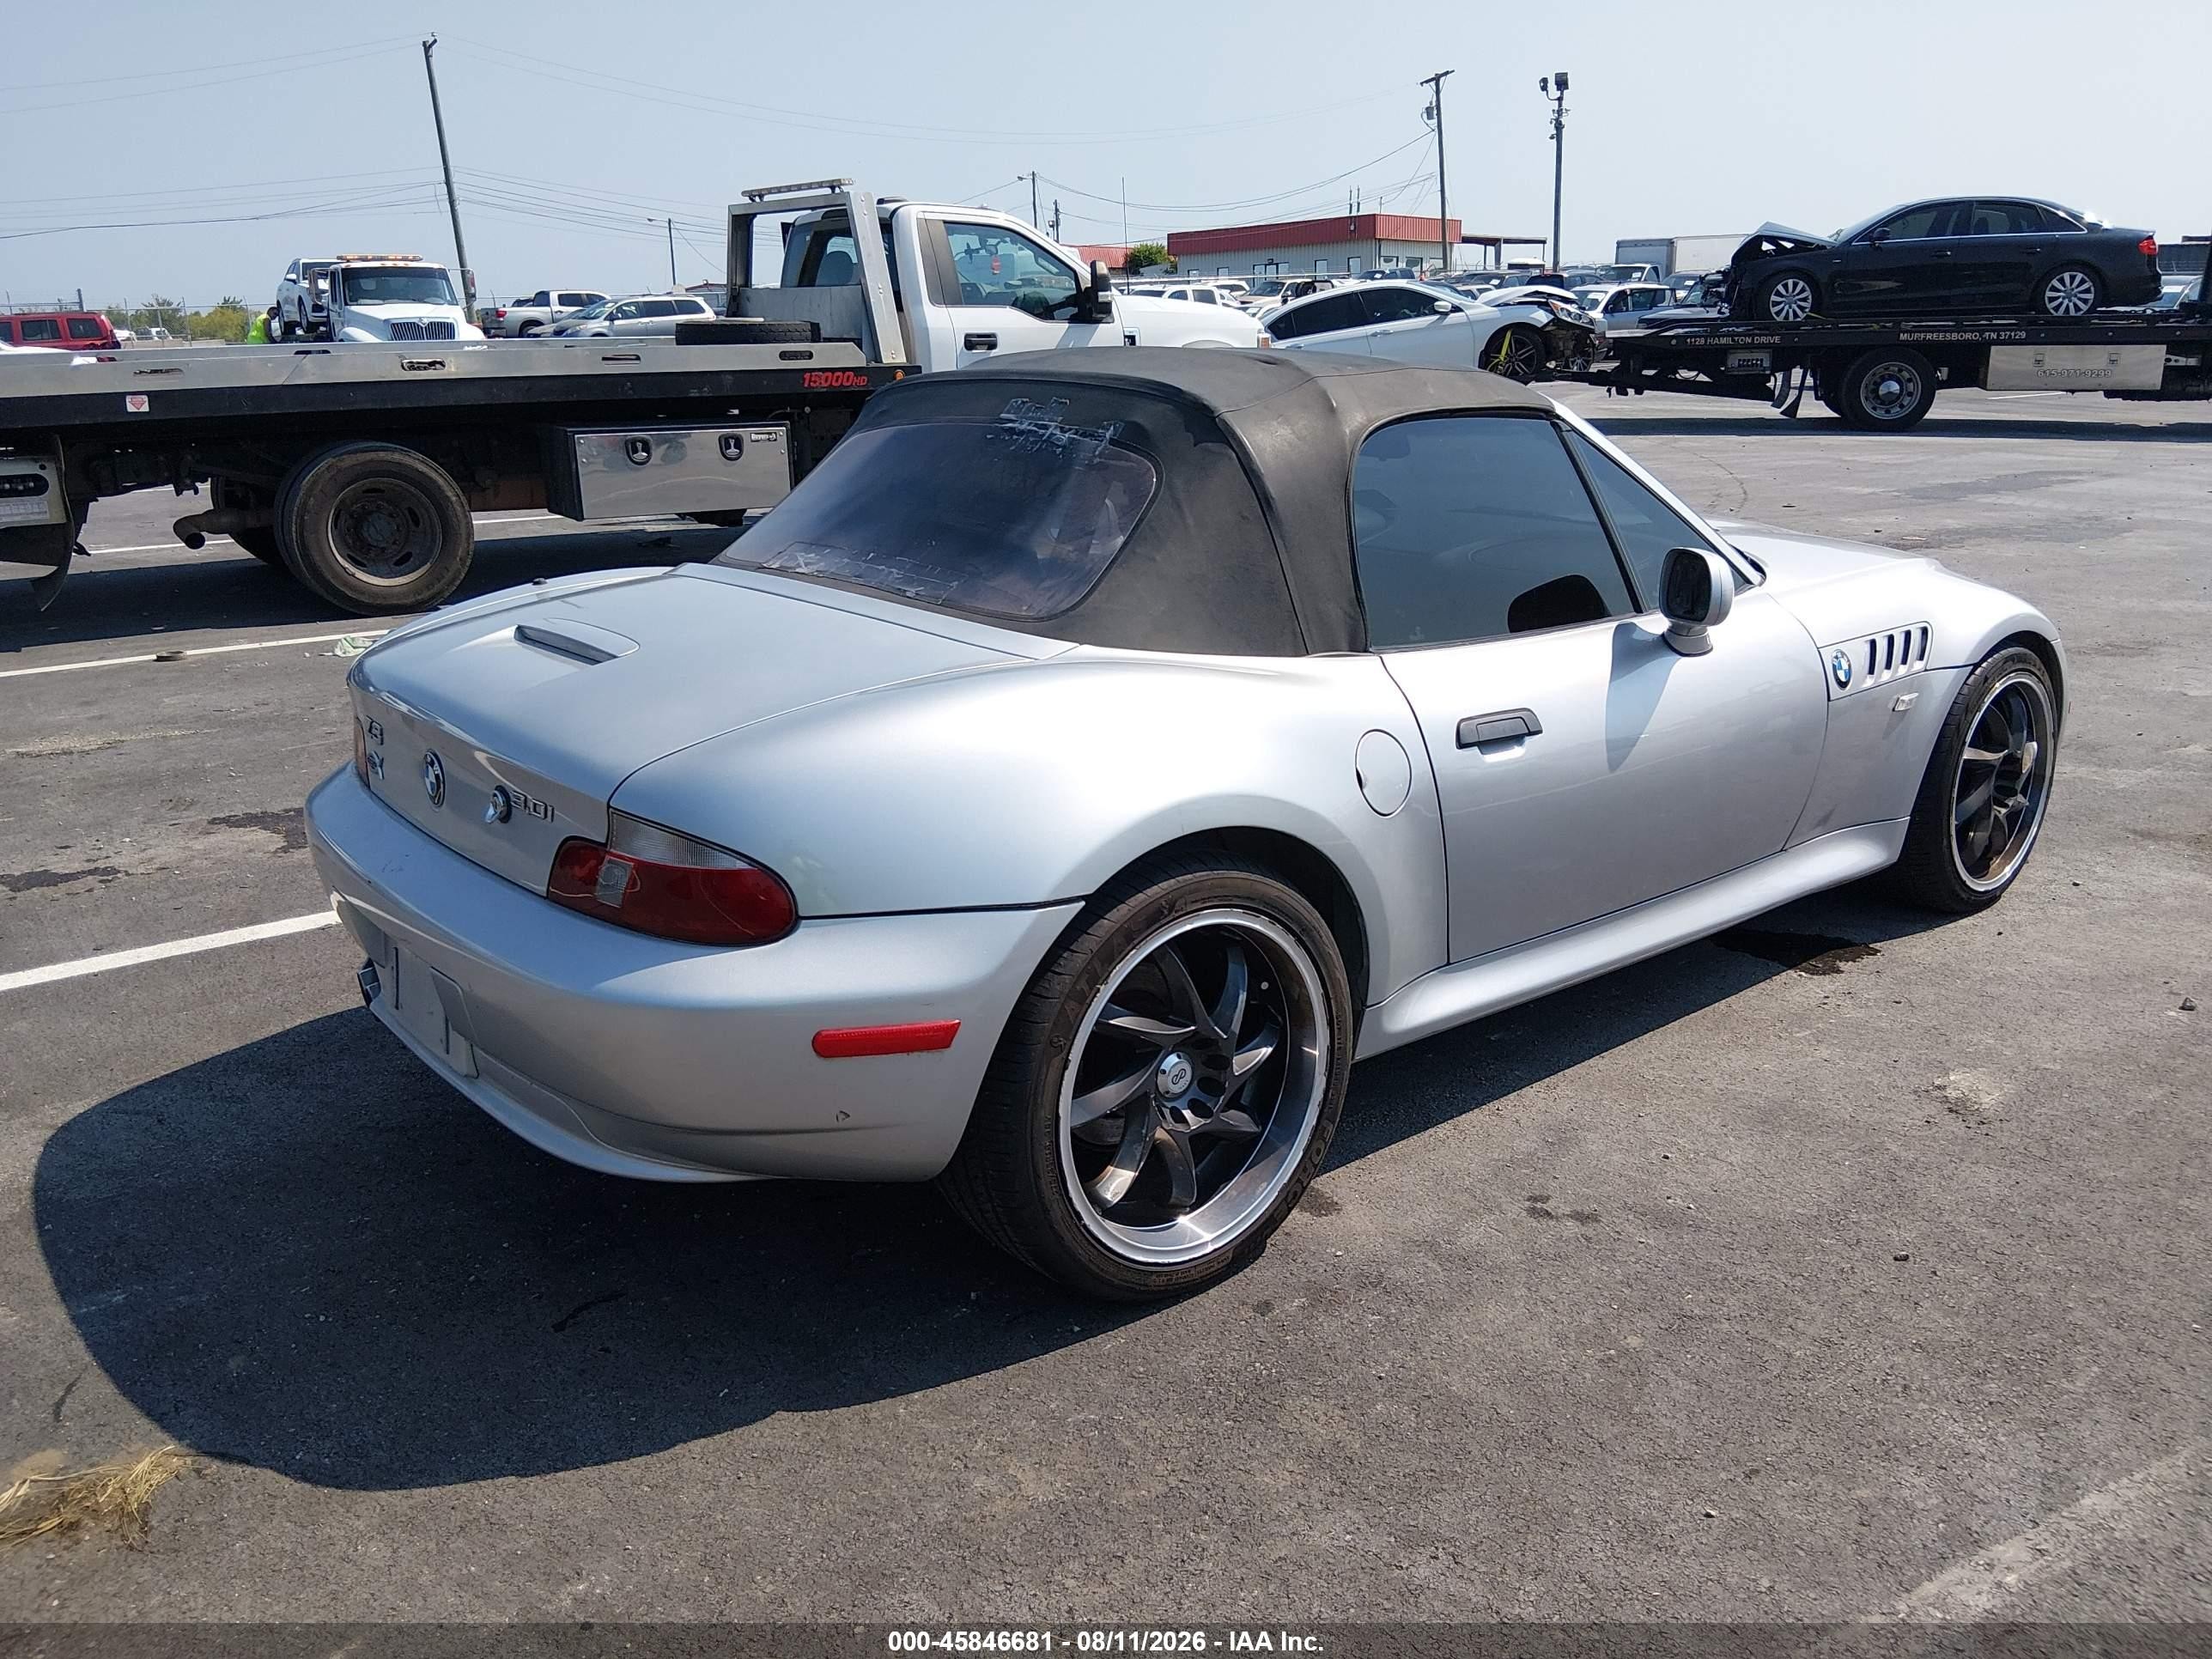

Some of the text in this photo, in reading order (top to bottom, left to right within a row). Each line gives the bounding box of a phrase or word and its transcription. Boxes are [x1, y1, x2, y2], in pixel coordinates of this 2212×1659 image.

[1706, 336, 1752, 344] HAMILTON
[1753, 335, 1782, 343] DRIVE
[1984, 331, 1998, 340] TN
[1999, 331, 2027, 339] 37129
[2037, 368, 2112, 379] 615-971-9299
